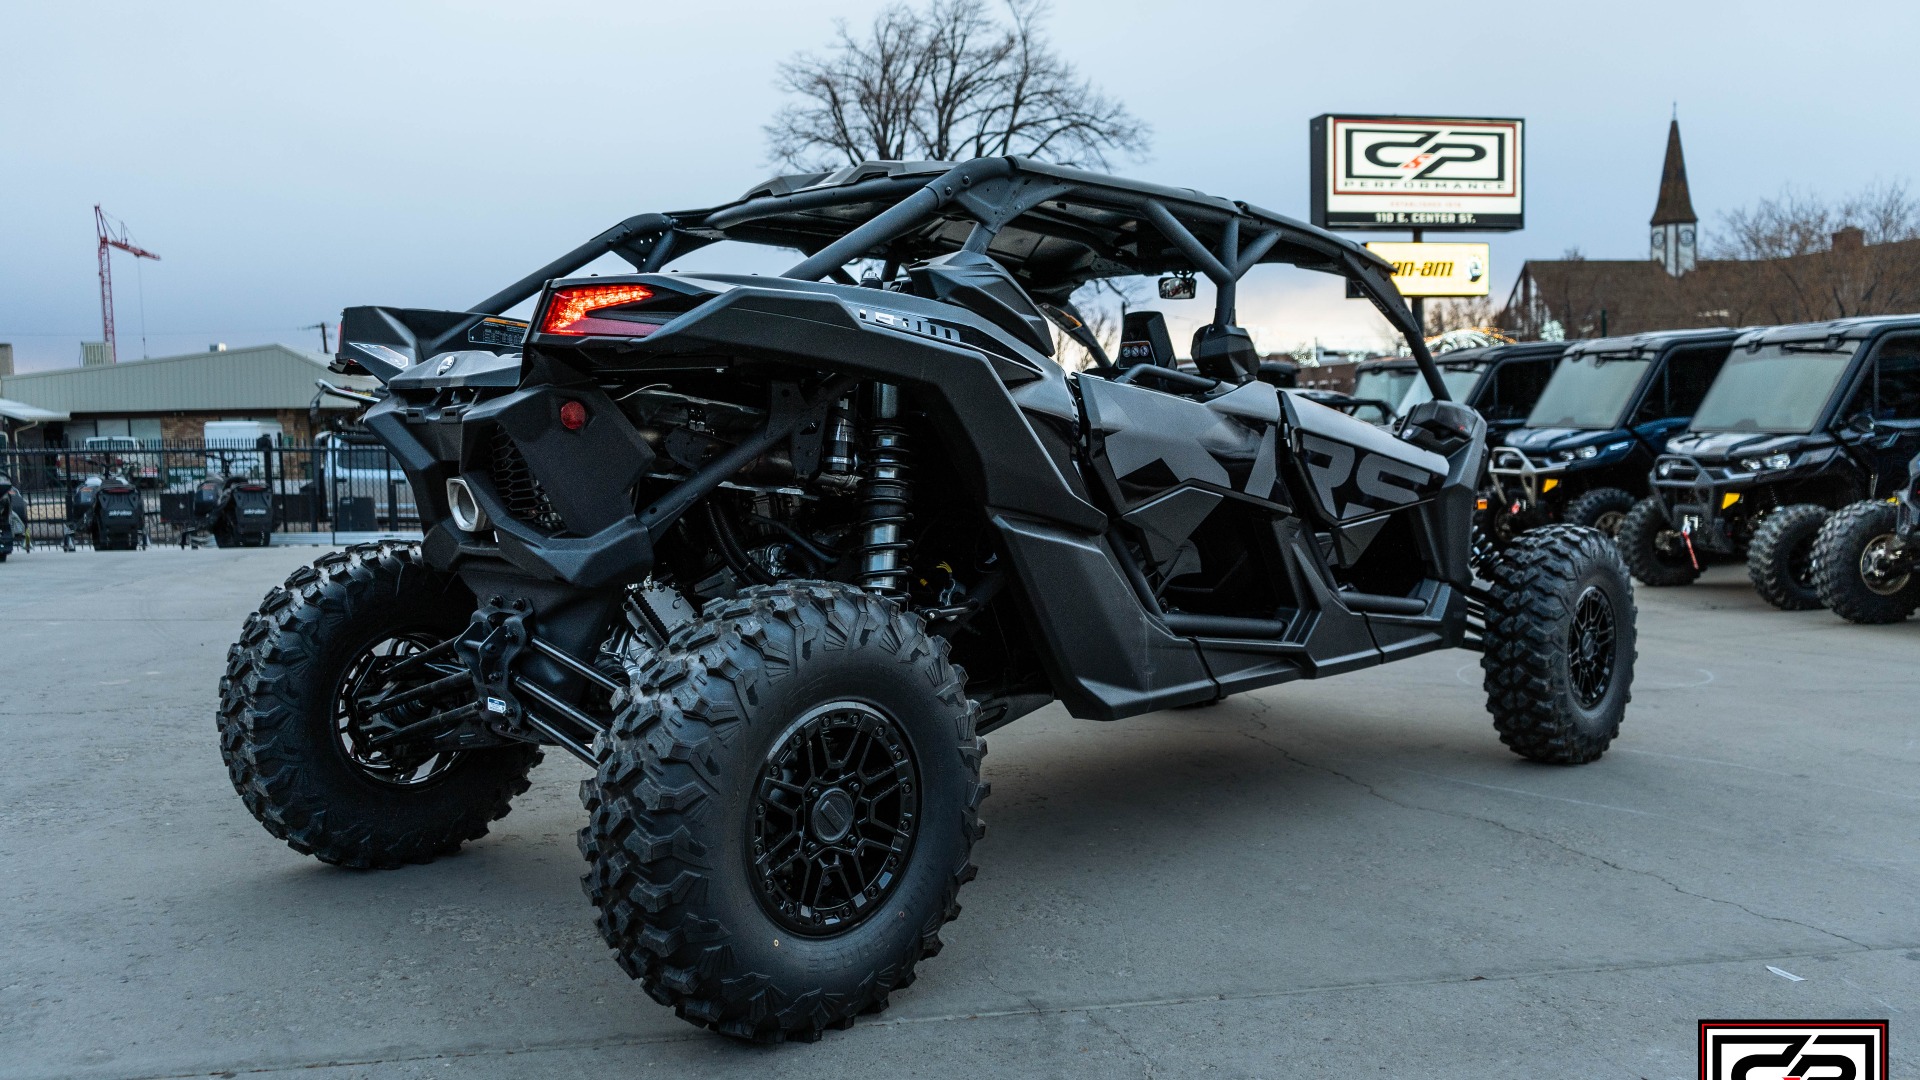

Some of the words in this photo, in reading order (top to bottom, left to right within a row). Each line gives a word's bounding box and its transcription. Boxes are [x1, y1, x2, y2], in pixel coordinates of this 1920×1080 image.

[1344, 181, 1505, 189] PERFORMANCE
[1375, 212, 1394, 223] 110
[1411, 212, 1456, 223] CENTER
[1391, 261, 1454, 276] an-am
